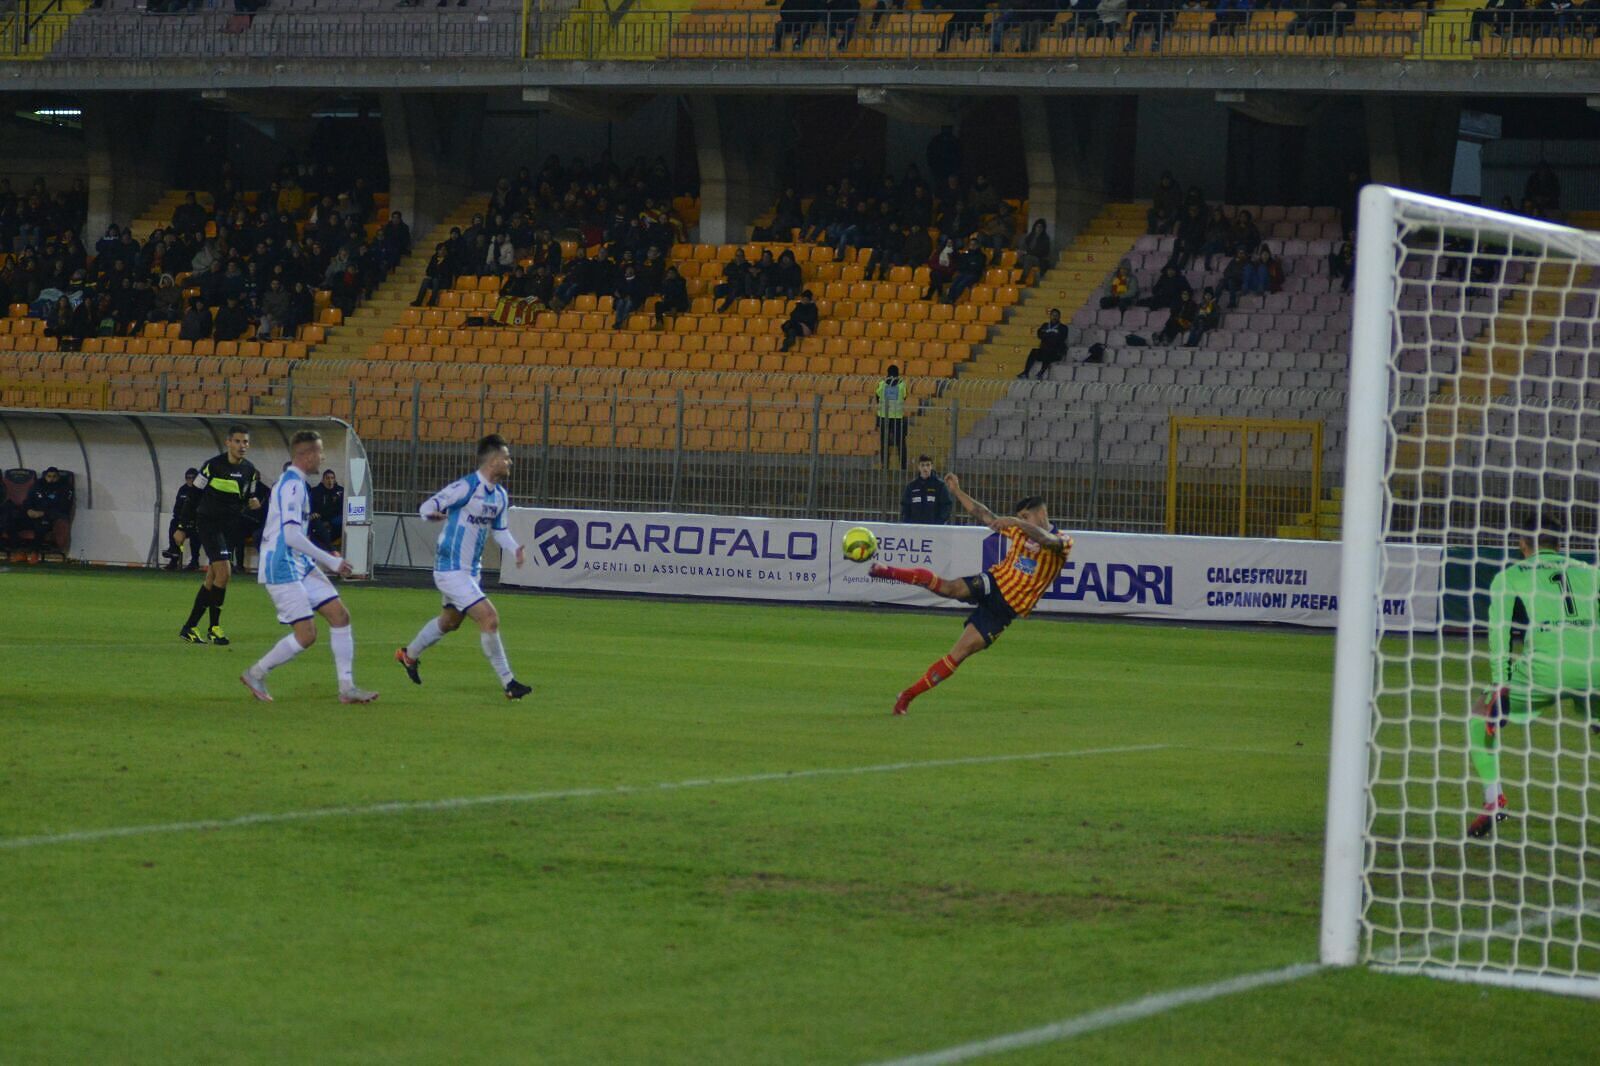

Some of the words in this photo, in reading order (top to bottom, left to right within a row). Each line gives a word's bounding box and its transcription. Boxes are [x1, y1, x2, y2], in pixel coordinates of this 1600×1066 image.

[586, 521, 817, 560] CAROFALO
[583, 561, 628, 573] AGENTI
[634, 563, 646, 574] DI
[652, 564, 752, 579] ASSICURAZIONE
[758, 570, 782, 581] DAL
[788, 571, 817, 583] 1989
[842, 575, 869, 584] Agenzia
[1207, 567, 1307, 586] CALCESTRUZZI
[1041, 562, 1173, 605] EADRI
[1549, 570, 1578, 617] 1
[1207, 591, 1287, 608] CAPANNONI
